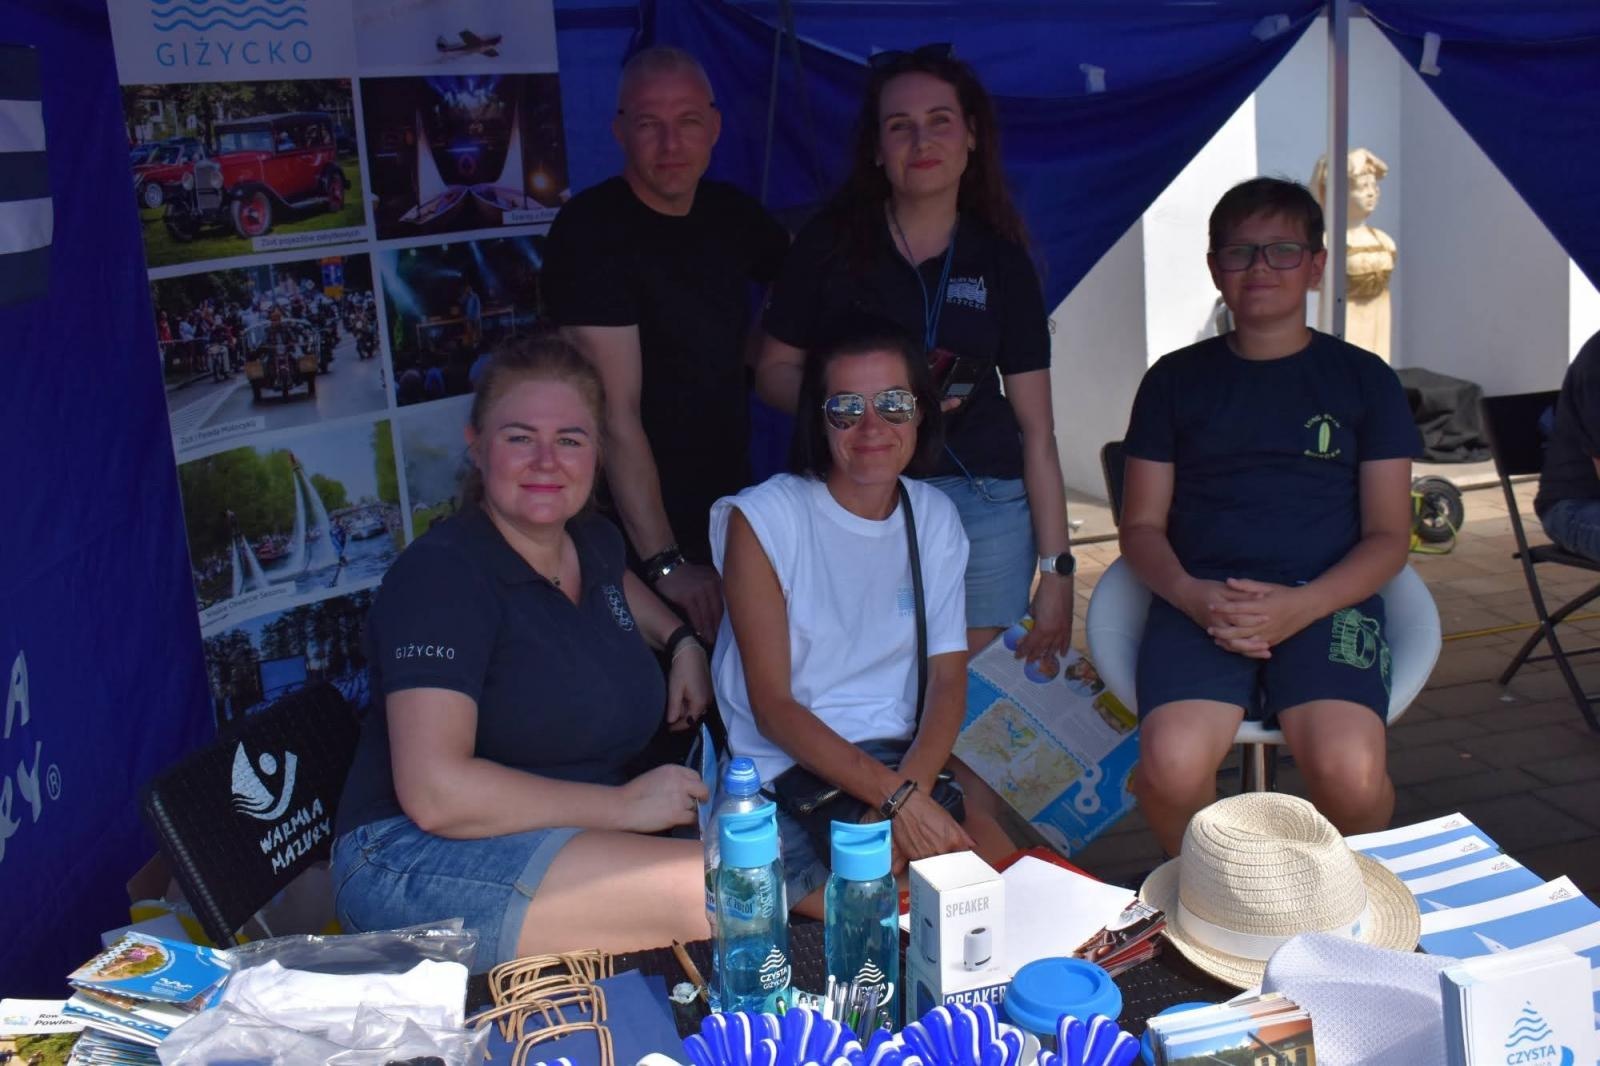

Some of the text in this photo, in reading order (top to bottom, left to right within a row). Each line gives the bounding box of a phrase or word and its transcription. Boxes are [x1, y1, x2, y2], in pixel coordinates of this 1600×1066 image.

[156, 36, 313, 66] GIŻYCKO
[395, 643, 455, 660] GIŻYCKO
[259, 798, 324, 855] WARMIA
[271, 817, 331, 875] MAZURY
[945, 896, 990, 919] SPEAKER
[760, 966, 788, 983] CZYSTA
[1506, 1044, 1556, 1065] CZYSTA
